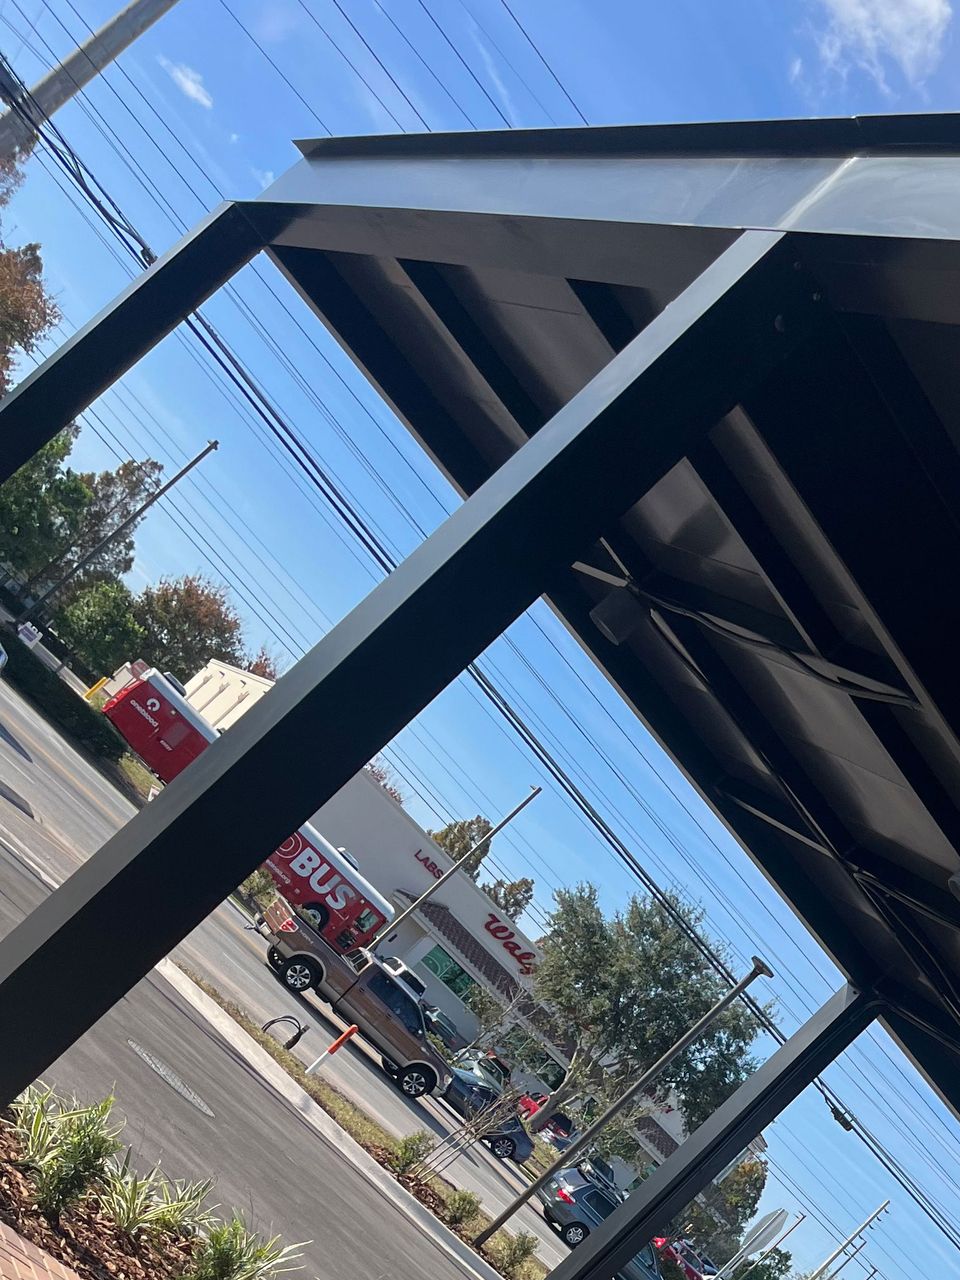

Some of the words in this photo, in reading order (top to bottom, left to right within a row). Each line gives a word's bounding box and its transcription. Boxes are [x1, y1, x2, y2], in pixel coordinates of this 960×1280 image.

[130, 699, 159, 727] oneblood
[289, 847, 356, 910] BUS
[414, 849, 444, 879] LABS
